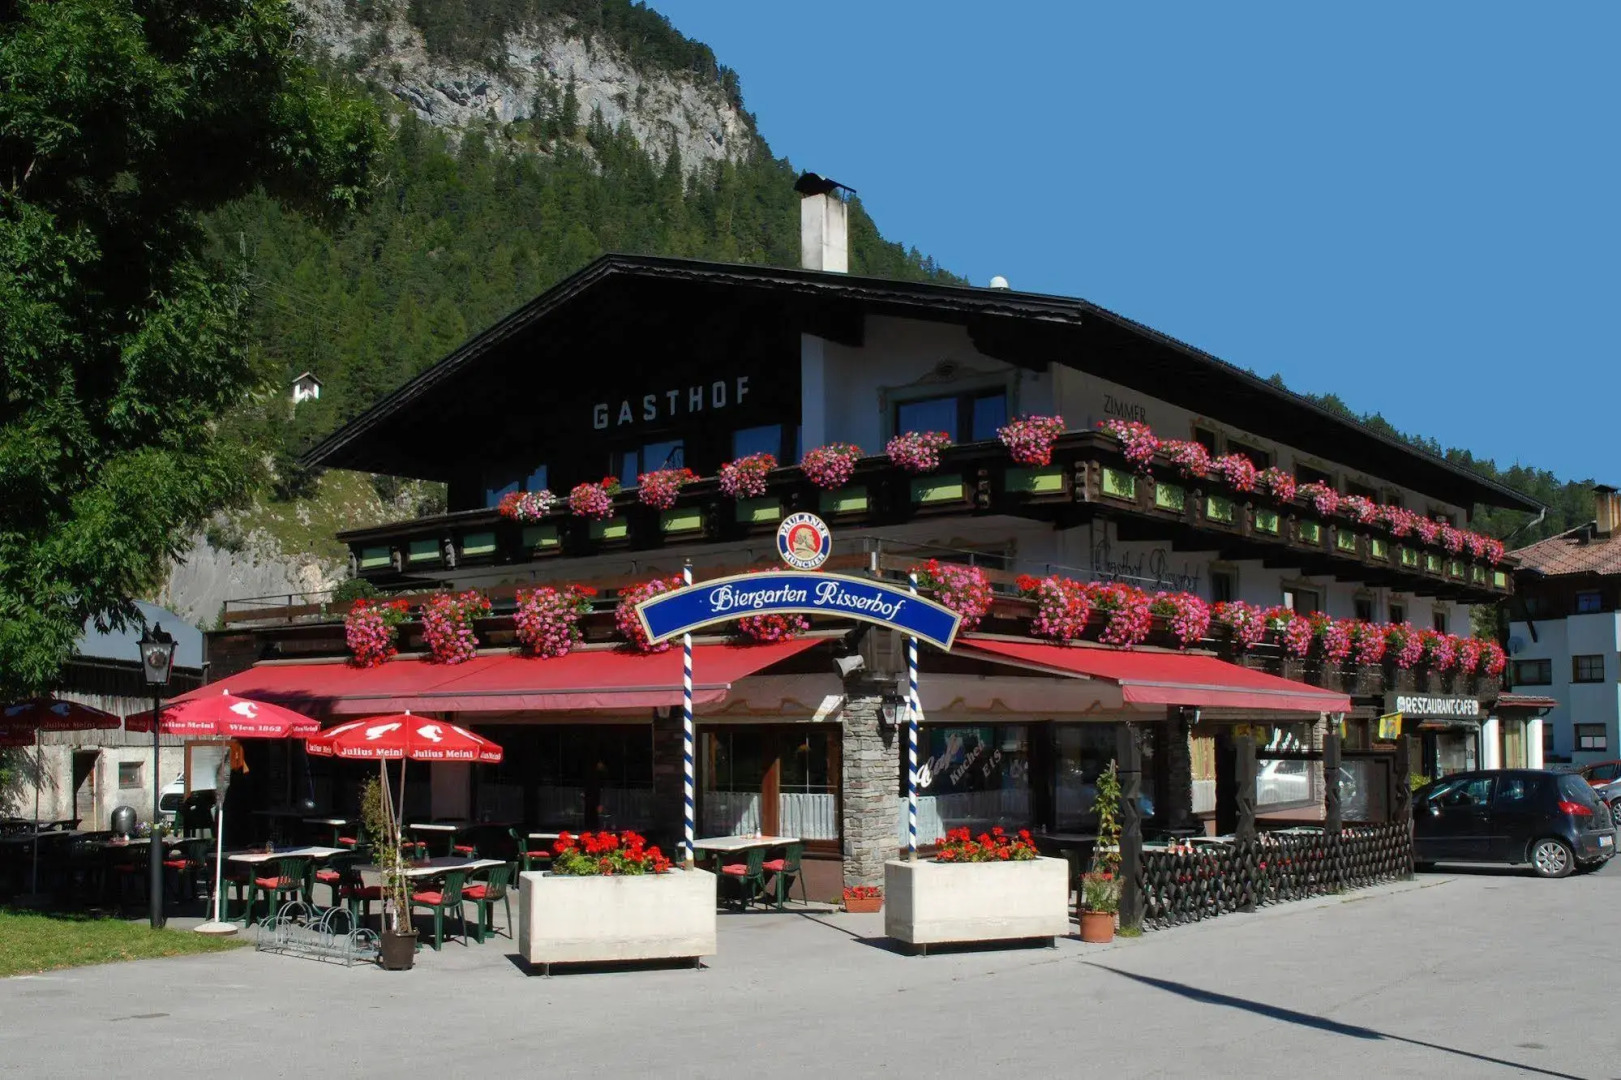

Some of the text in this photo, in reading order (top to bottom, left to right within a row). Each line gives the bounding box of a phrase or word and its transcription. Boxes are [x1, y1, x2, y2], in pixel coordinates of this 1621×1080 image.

[593, 376, 749, 430] GASTHOF
[1103, 394, 1146, 424] ZIMMER
[780, 514, 829, 538] PAULANER
[709, 581, 906, 621] Biergarten Risserhof
[187, 721, 214, 729] Meinl
[229, 723, 282, 732] Wien 1862
[341, 748, 403, 756] Julius Meinl
[413, 750, 443, 758] Julius
[446, 750, 473, 758] Meinl
